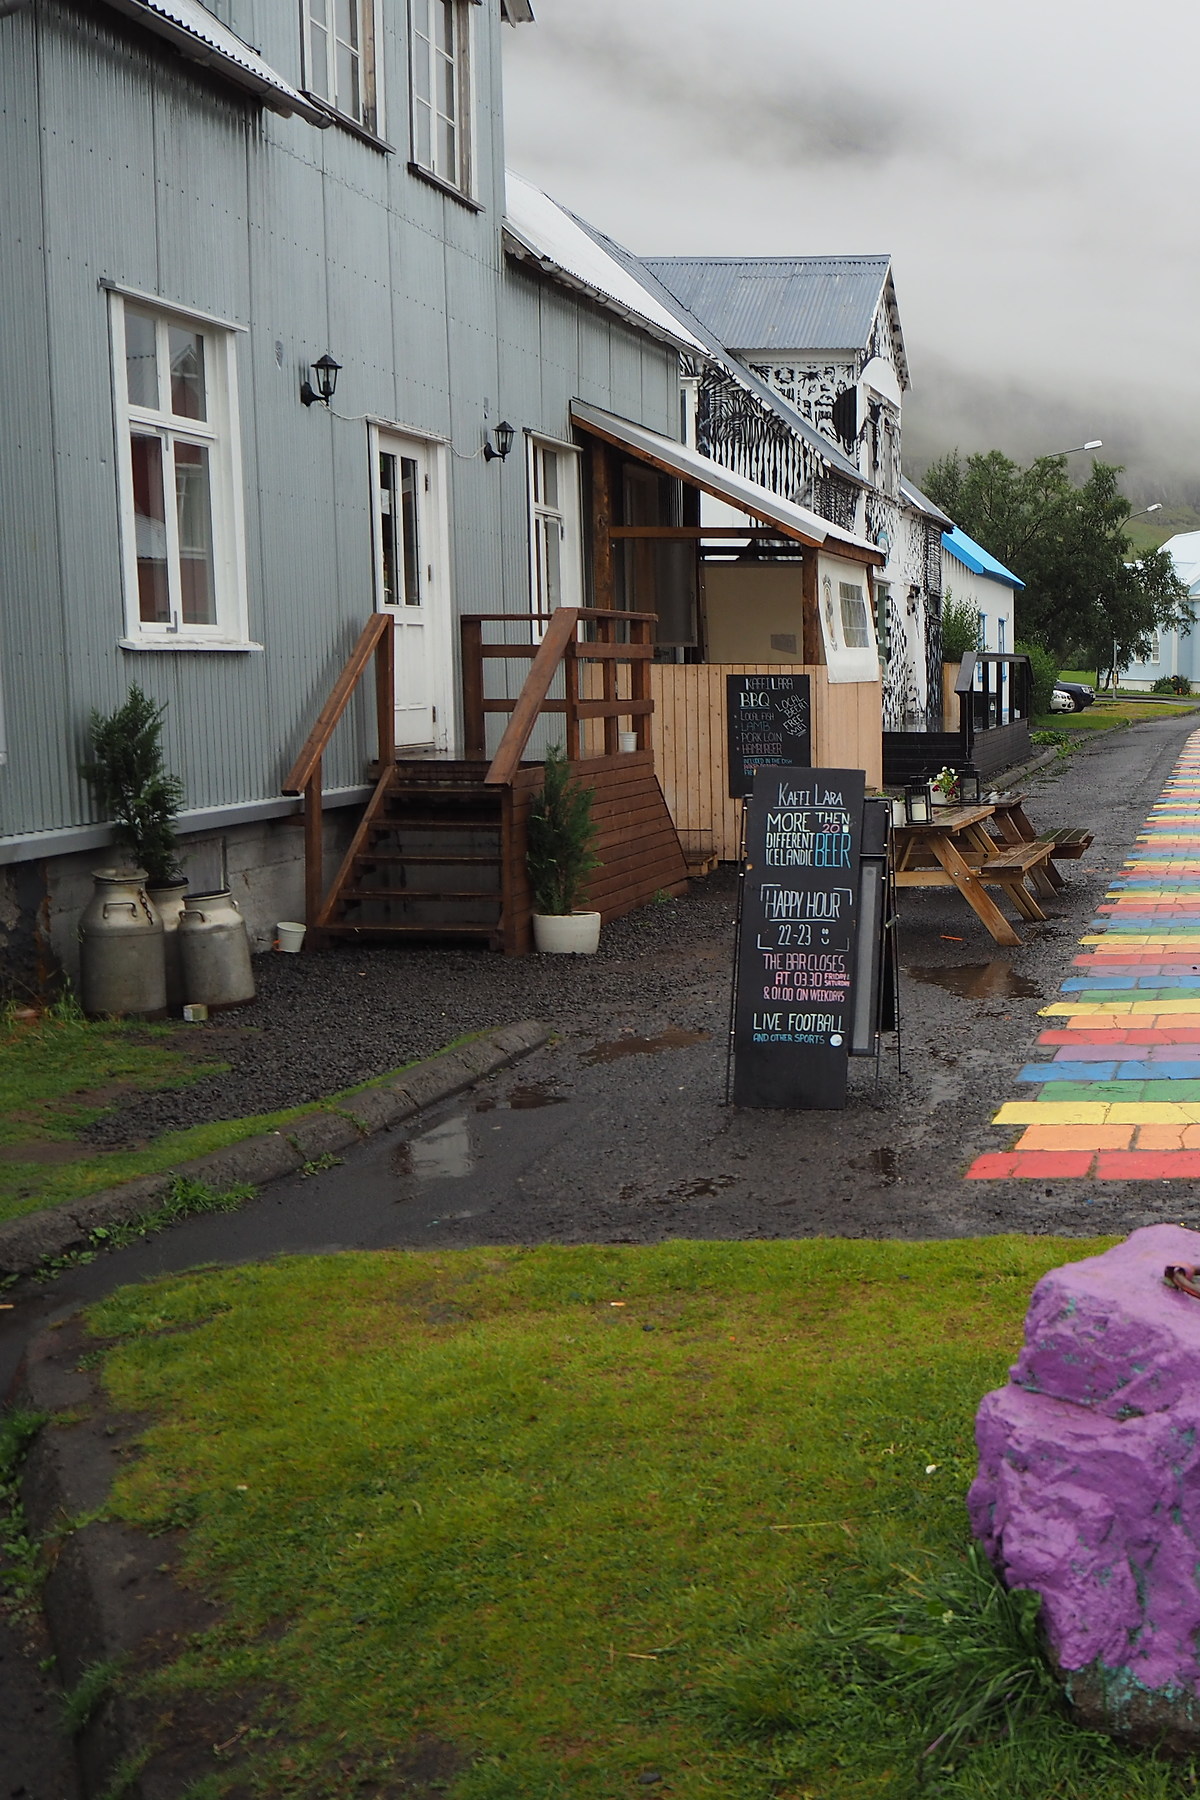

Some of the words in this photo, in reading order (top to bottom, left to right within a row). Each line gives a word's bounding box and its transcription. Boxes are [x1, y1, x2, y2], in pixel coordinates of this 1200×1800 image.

[745, 678, 770, 690] KAFFI
[771, 677, 794, 690] LARA
[740, 692, 770, 707] BBQ
[774, 694, 804, 712] LOCAL
[740, 711, 758, 721] LOCAL
[783, 714, 804, 730] FREE
[741, 722, 770, 731] LAMB
[741, 732, 762, 743] PORK
[763, 732, 783, 742] LOIN
[742, 743, 782, 754] HAMBURGER
[814, 783, 843, 806] LARA
[767, 812, 811, 832] MORE
[815, 811, 850, 825] THEN
[821, 823, 840, 833] 20
[766, 832, 815, 849] DIFFERENT
[765, 848, 814, 867] ICELANDIC
[814, 833, 851, 868] BEER
[765, 889, 804, 918] HAPPY
[806, 891, 841, 918] HOUR
[763, 953, 785, 970] THE
[786, 953, 806, 971] BAR
[807, 954, 845, 972] CLOSES
[775, 971, 791, 985] AT
[793, 972, 823, 988] 03.30
[763, 987, 770, 1000] &
[771, 986, 794, 1001] 01.00
[796, 988, 809, 1001] ON
[809, 988, 845, 1002] WEEKDAYS
[753, 1013, 783, 1030] LIVE
[788, 1013, 845, 1034] FOOTBALL
[753, 1034, 770, 1042] AND
[770, 1034, 793, 1043] OTHER
[794, 1034, 825, 1044] SPORTS
